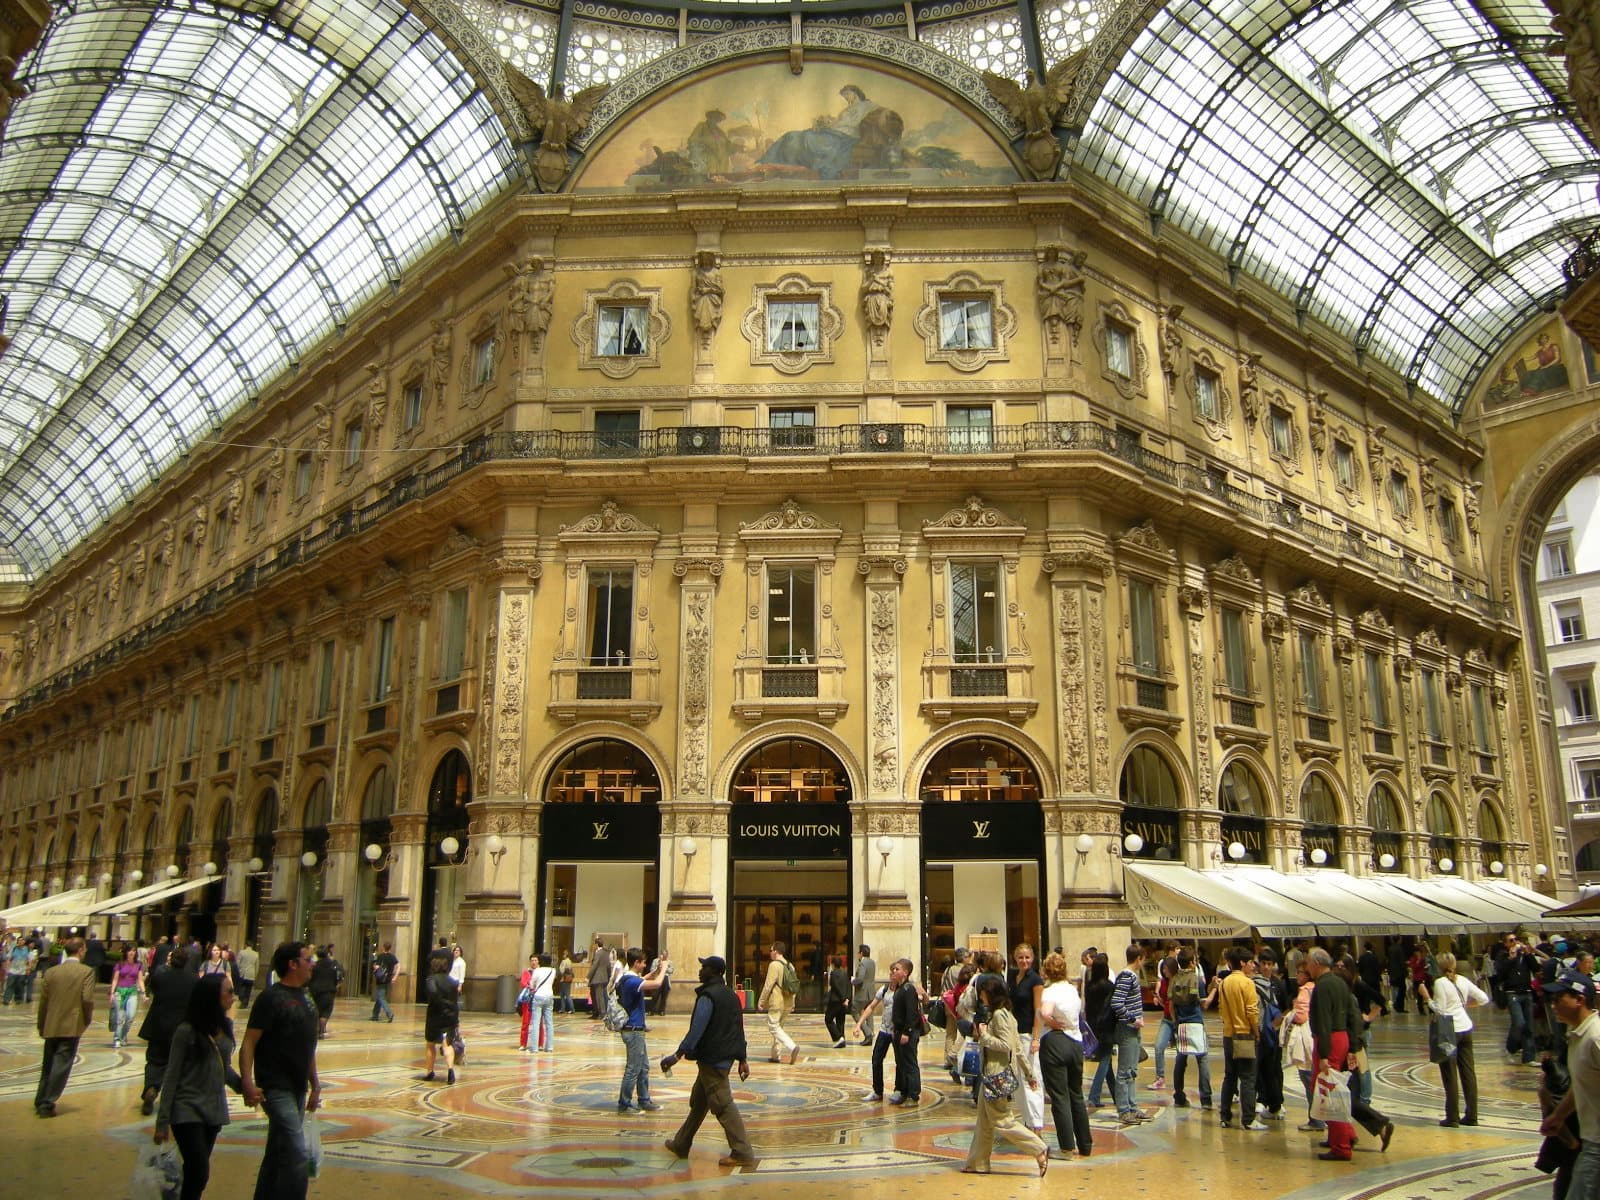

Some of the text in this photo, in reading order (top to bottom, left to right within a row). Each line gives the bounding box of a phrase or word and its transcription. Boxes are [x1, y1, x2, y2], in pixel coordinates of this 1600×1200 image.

[739, 824, 841, 837] LOUIS VUITTON
[1123, 820, 1172, 845] SAVINI
[1159, 914, 1220, 925] RISTORANTE
[1191, 927, 1234, 936] BISTROT
